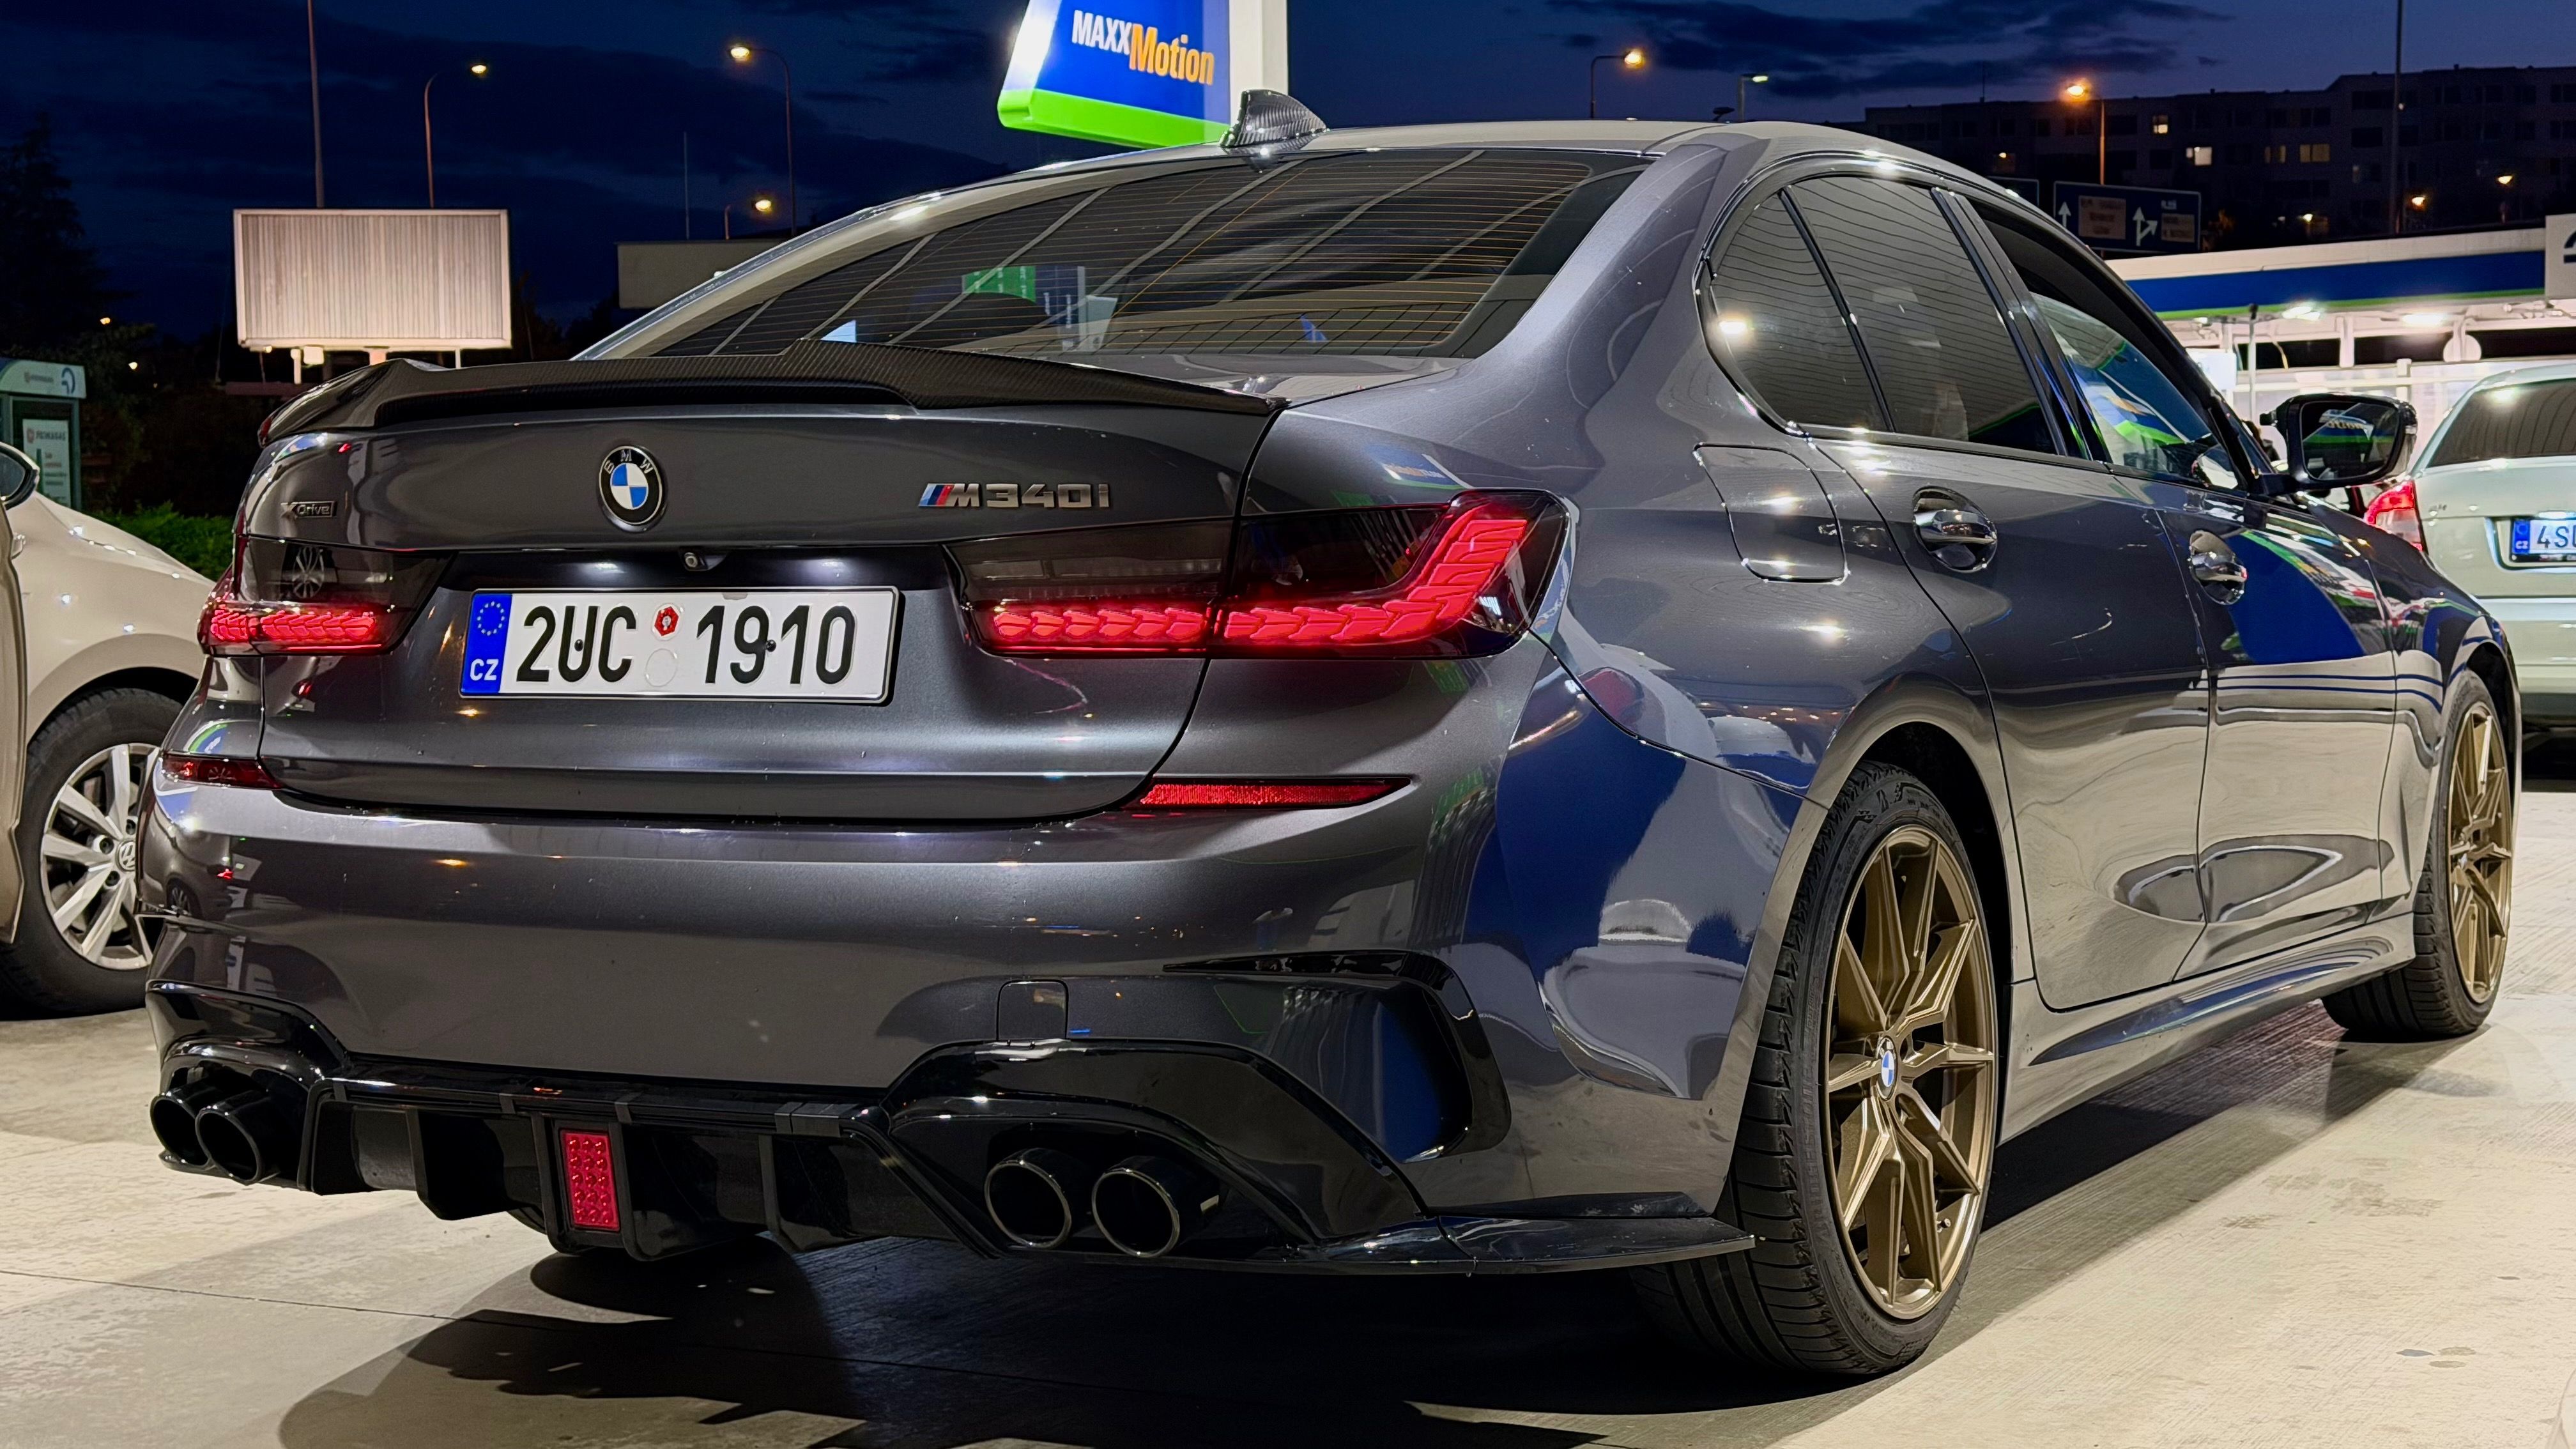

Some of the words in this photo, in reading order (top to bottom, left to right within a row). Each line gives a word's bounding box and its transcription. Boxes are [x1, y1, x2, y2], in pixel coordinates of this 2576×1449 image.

[1071, 10, 1215, 86] MAXXMotion
[604, 449, 654, 474] BMW
[2515, 540, 2529, 549] CZ
[2536, 525, 2576, 548] 4S
[516, 605, 637, 683] 2UC
[696, 605, 856, 684] 1910
[470, 659, 499, 681] CZ
